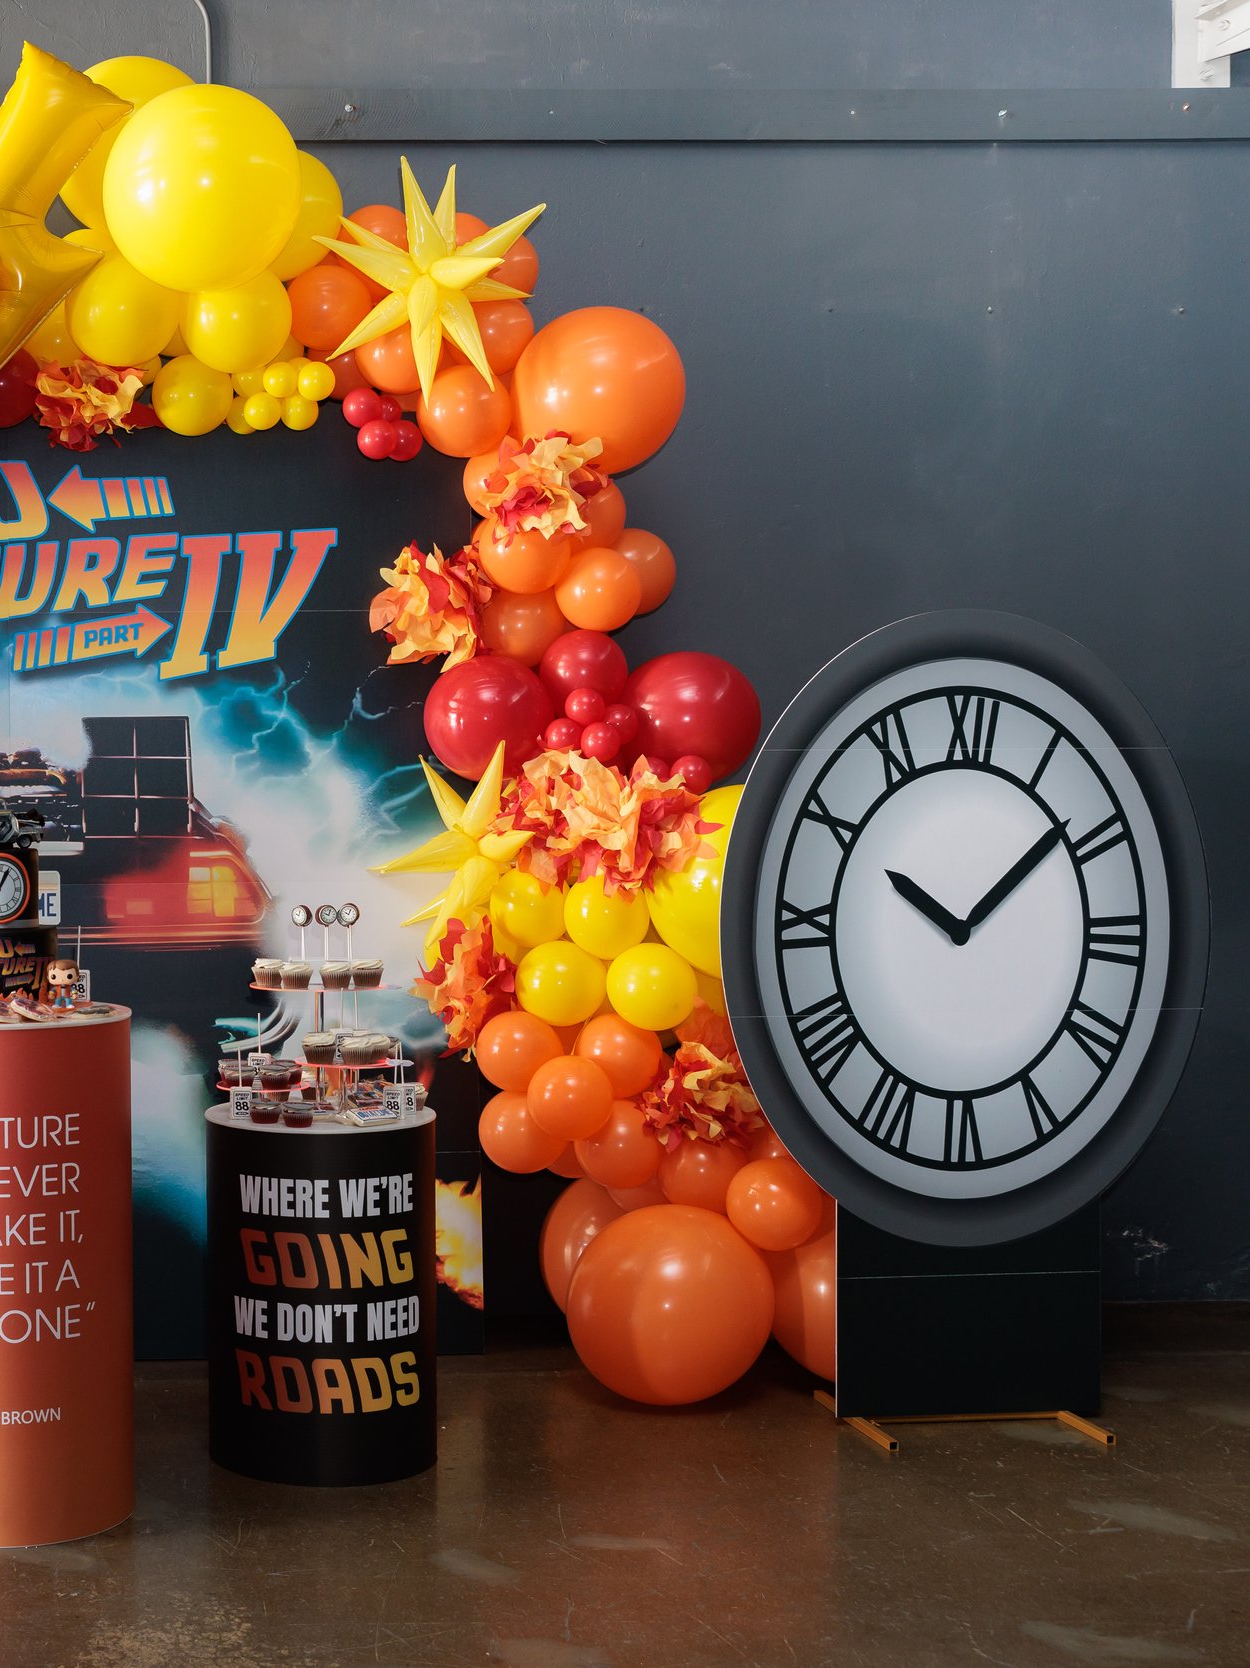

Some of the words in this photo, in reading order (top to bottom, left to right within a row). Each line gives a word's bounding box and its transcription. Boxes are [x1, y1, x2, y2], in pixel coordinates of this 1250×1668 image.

[82, 622, 143, 650] PART
[158, 527, 338, 682] IV
[863, 707, 918, 790] XI
[944, 693, 1000, 766] XII
[801, 788, 859, 854] X
[1071, 811, 1130, 868] II
[776, 898, 837, 952] IX
[1085, 913, 1144, 968] III
[791, 992, 862, 1088] VIII
[1065, 999, 1126, 1075] IV
[235, 1101, 249, 1111] 88
[386, 1101, 400, 1110] 88
[406, 1097, 413, 1106] 8
[856, 1072, 918, 1155] VII
[942, 1094, 986, 1168] VI
[1019, 1072, 1063, 1143] V
[239, 1173, 330, 1219] WHERE
[338, 1173, 414, 1218] WE'RE
[58, 1209, 84, 1244] IT,
[25, 1261, 49, 1295] IT
[55, 1258, 80, 1289] A
[239, 1228, 415, 1290] GOING
[233, 1295, 269, 1339] WE
[276, 1302, 358, 1344] DON'T
[366, 1295, 420, 1342] NEED
[235, 1348, 421, 1415] ROADS
[1, 1407, 62, 1426] BROWN
